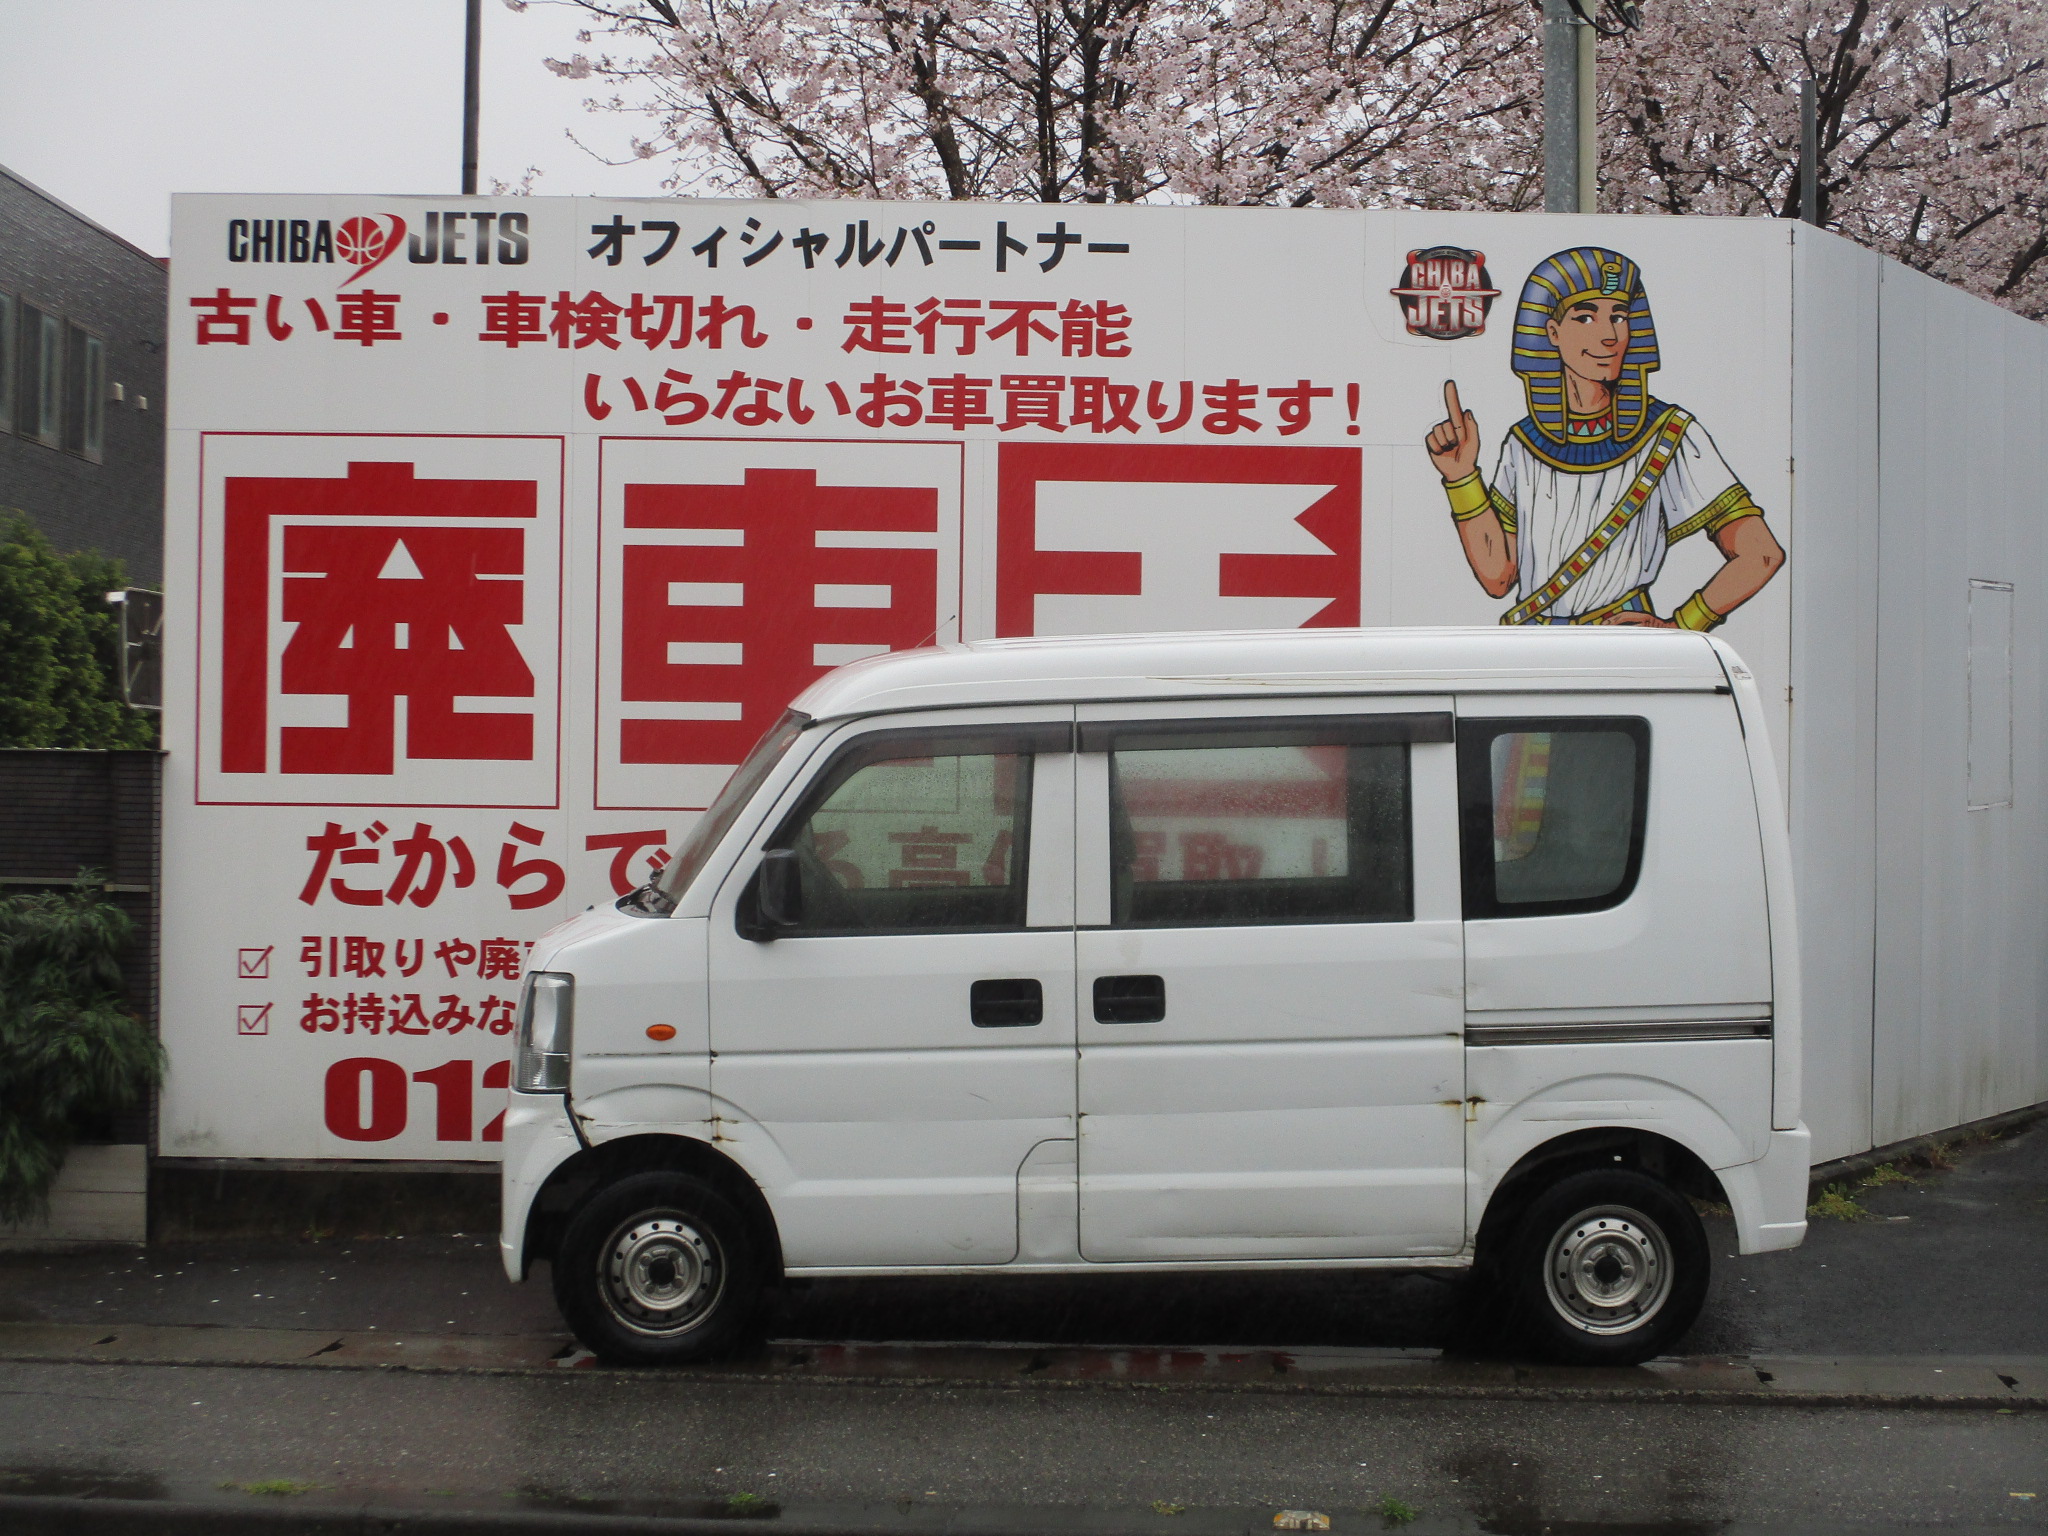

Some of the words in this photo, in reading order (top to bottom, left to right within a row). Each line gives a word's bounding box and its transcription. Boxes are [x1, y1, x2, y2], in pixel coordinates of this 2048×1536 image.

[229, 219, 335, 263] CHIBA
[408, 211, 529, 265] JETS
[588, 214, 1130, 273] オフィシャルパートナー
[1411, 259, 1481, 290] CHIBA
[190, 288, 1133, 358] 古い車・車検切れ・走行不能
[1406, 296, 1484, 331] JETS
[300, 935, 535, 981] 引取りや廃
